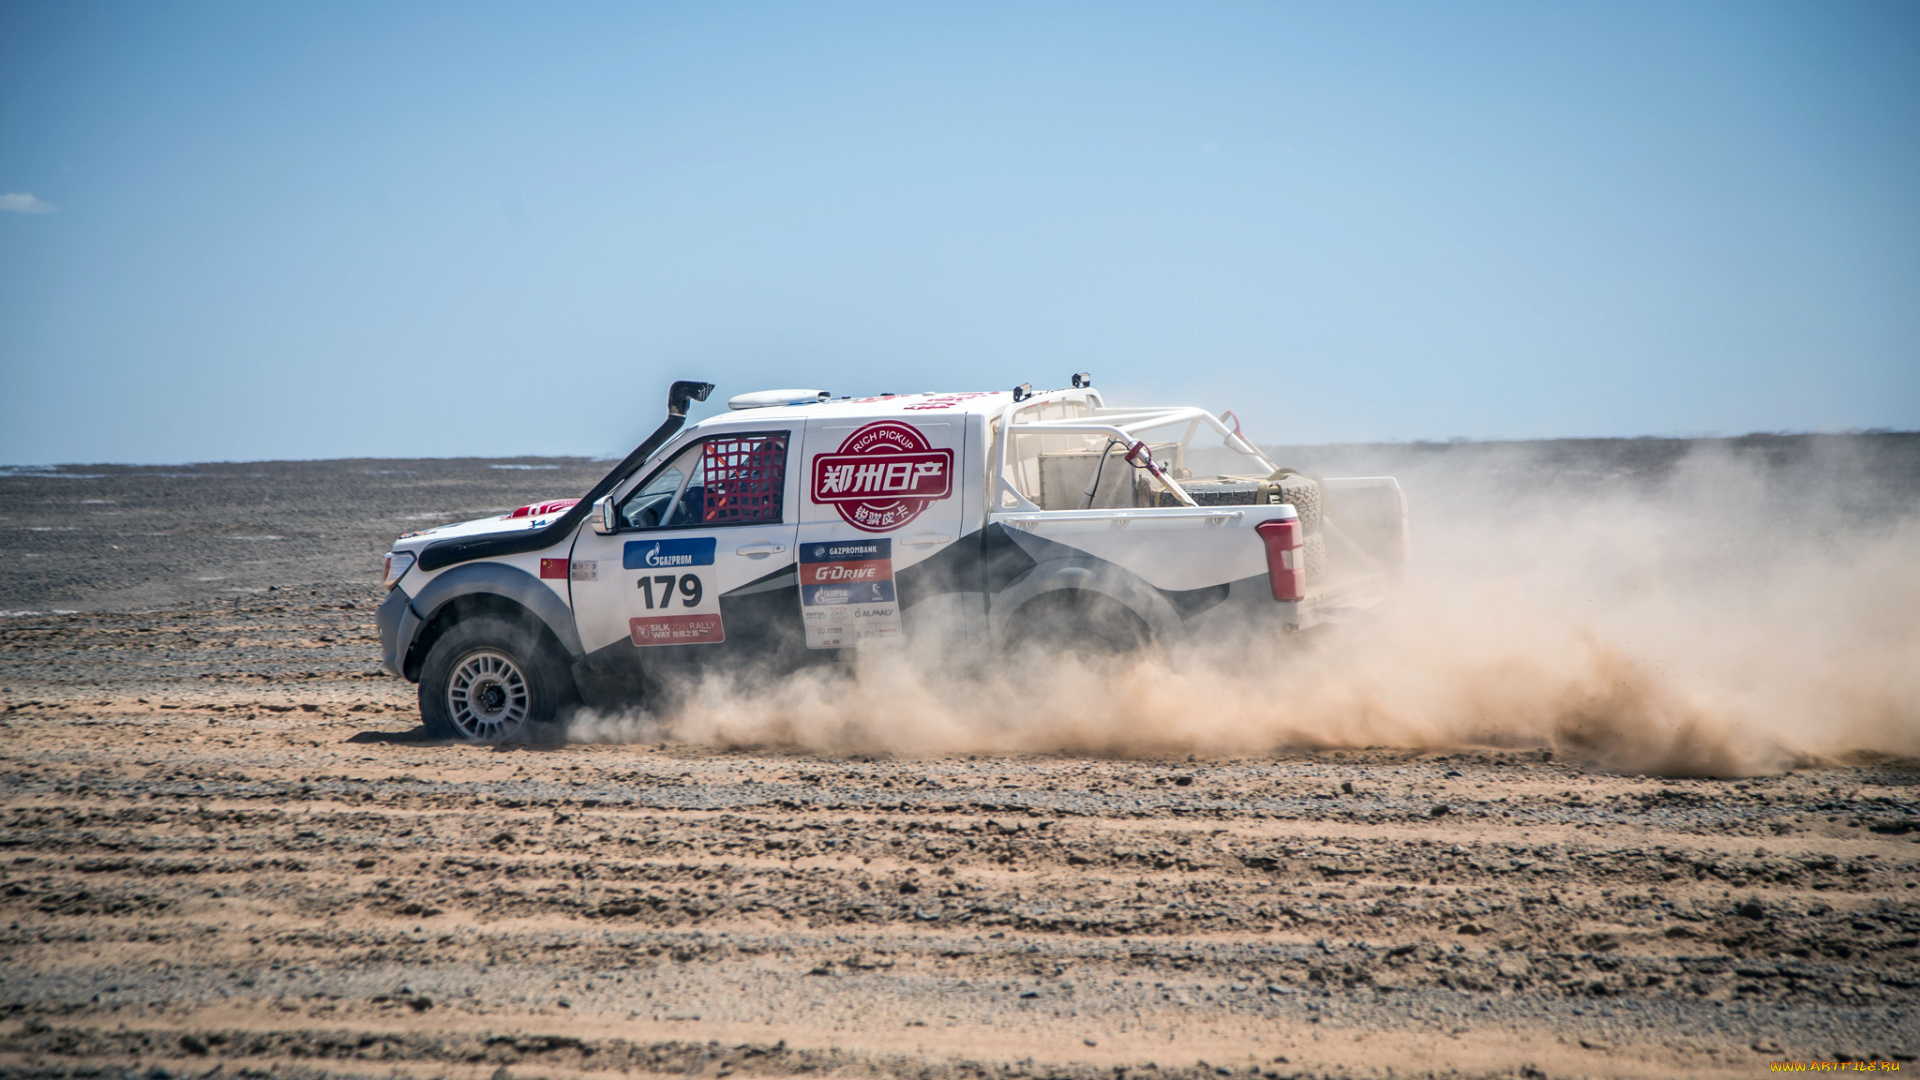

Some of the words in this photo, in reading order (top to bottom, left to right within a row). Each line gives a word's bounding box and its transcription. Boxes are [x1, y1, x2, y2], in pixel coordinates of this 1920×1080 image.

[853, 432, 877, 453] RICH
[879, 430, 914, 450] PICKUP
[820, 461, 943, 494] 郑州日产
[829, 546, 877, 555] GAZPROMBANK
[660, 555, 692, 566] GAZPROM
[637, 573, 703, 609] 179
[862, 608, 893, 618] ALMALY
[650, 624, 670, 632] SILK
[689, 621, 716, 630] RALLY
